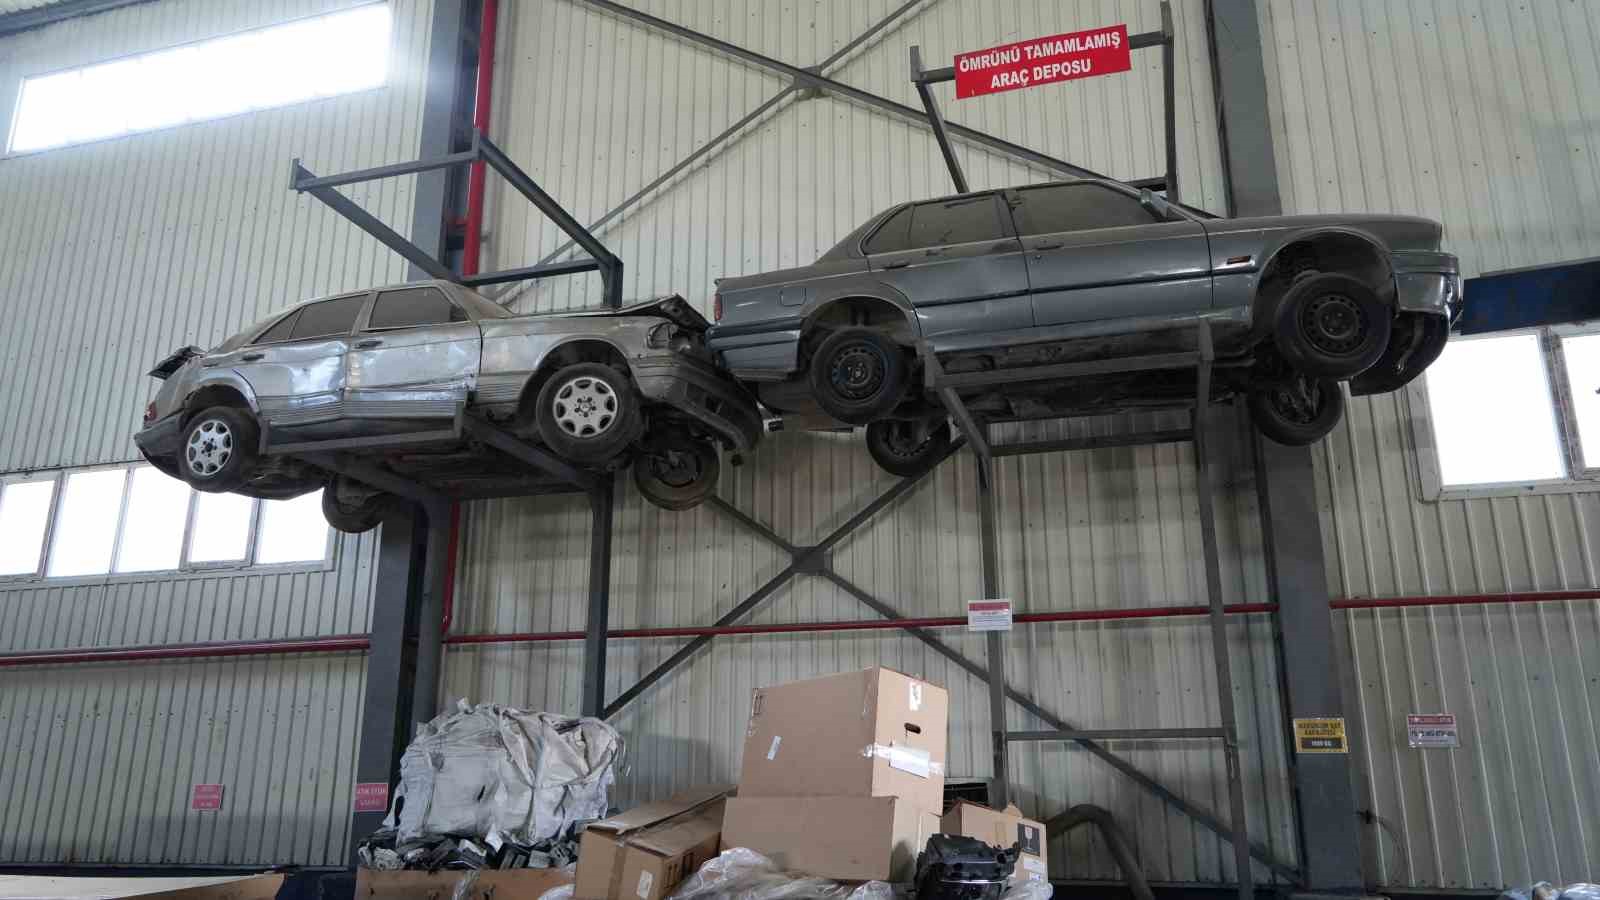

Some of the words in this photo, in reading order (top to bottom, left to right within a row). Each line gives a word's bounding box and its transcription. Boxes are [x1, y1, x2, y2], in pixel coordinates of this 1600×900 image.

[959, 46, 1021, 72] ÖMRÜNÜ
[1024, 32, 1121, 60] TAMAMLAMIŞ
[991, 69, 1029, 89] ARAÇ
[1033, 59, 1091, 81] DEPOSU
